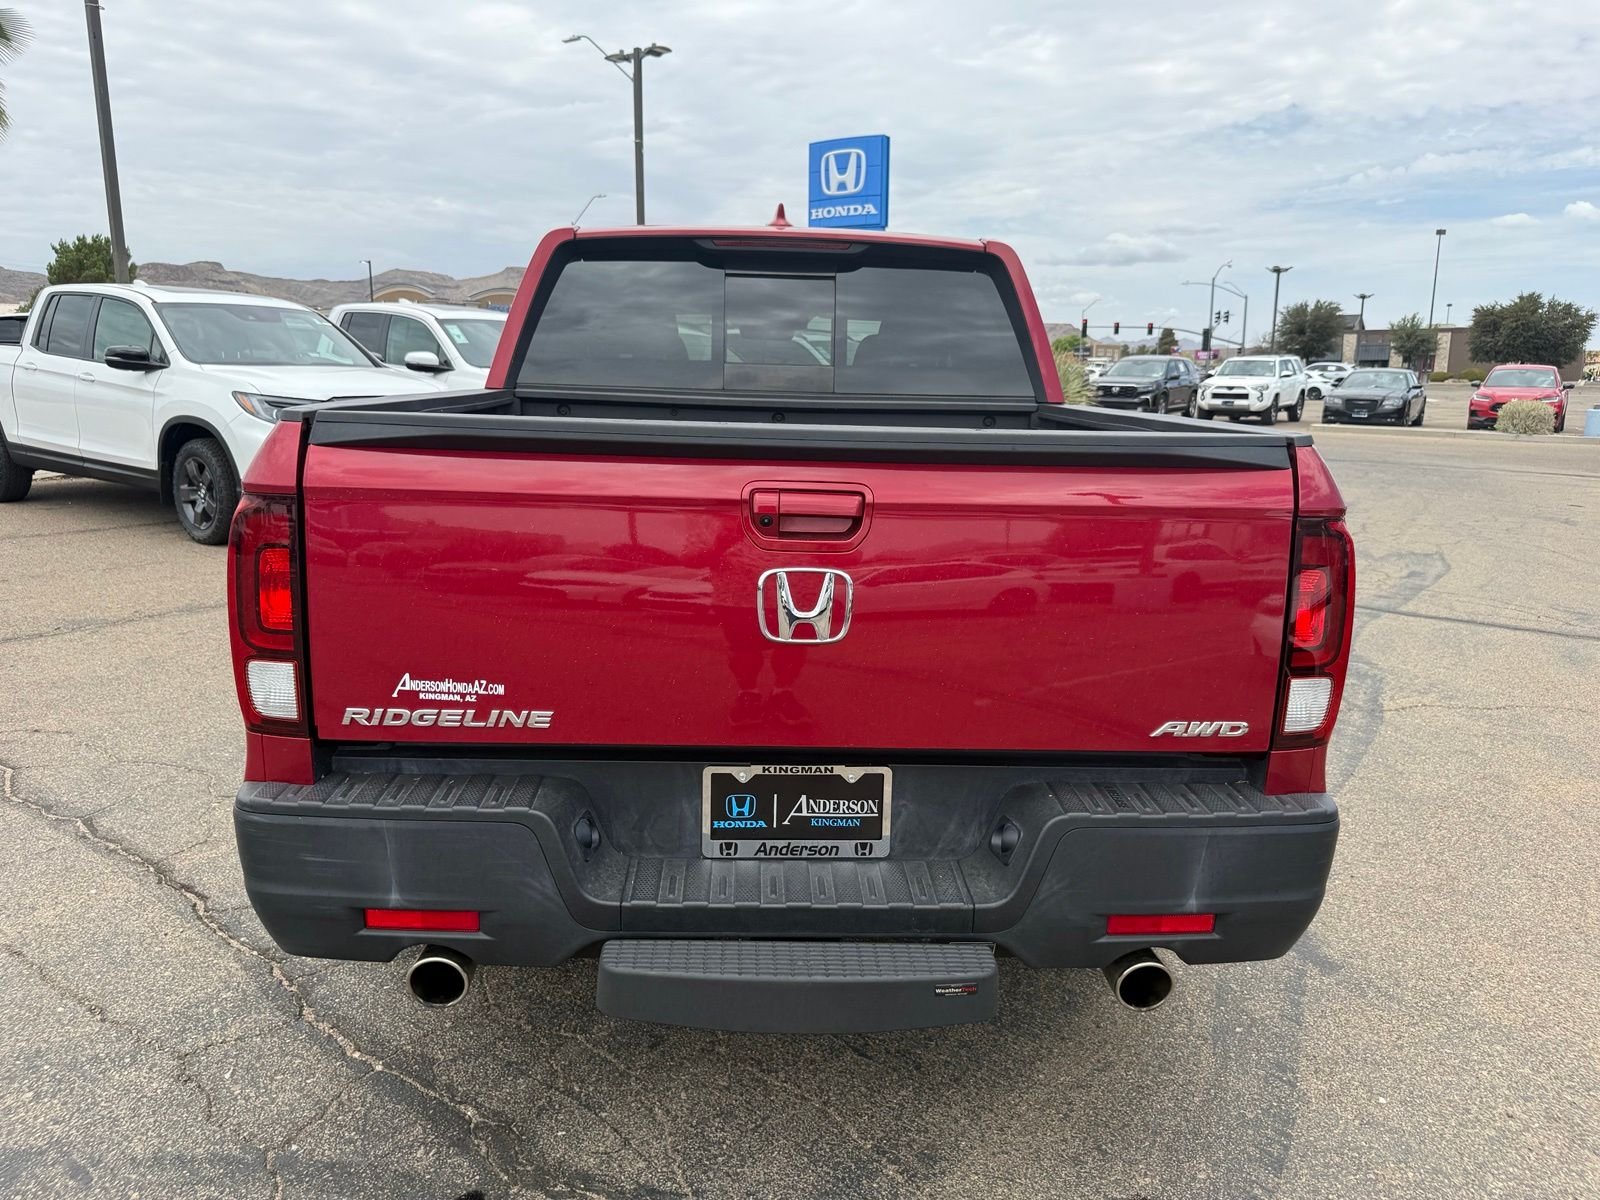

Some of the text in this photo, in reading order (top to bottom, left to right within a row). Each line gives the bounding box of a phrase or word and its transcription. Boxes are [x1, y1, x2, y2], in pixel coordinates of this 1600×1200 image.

[810, 203, 878, 219] HONDA
[419, 692, 477, 702] KINGMAN, AZ
[341, 707, 554, 728] RIDGELINE
[1149, 721, 1249, 737] AWD
[762, 766, 834, 774] KINGMAN
[713, 820, 767, 829] HONDA
[811, 818, 861, 827] KINGMAN
[754, 842, 840, 857] Anderson
